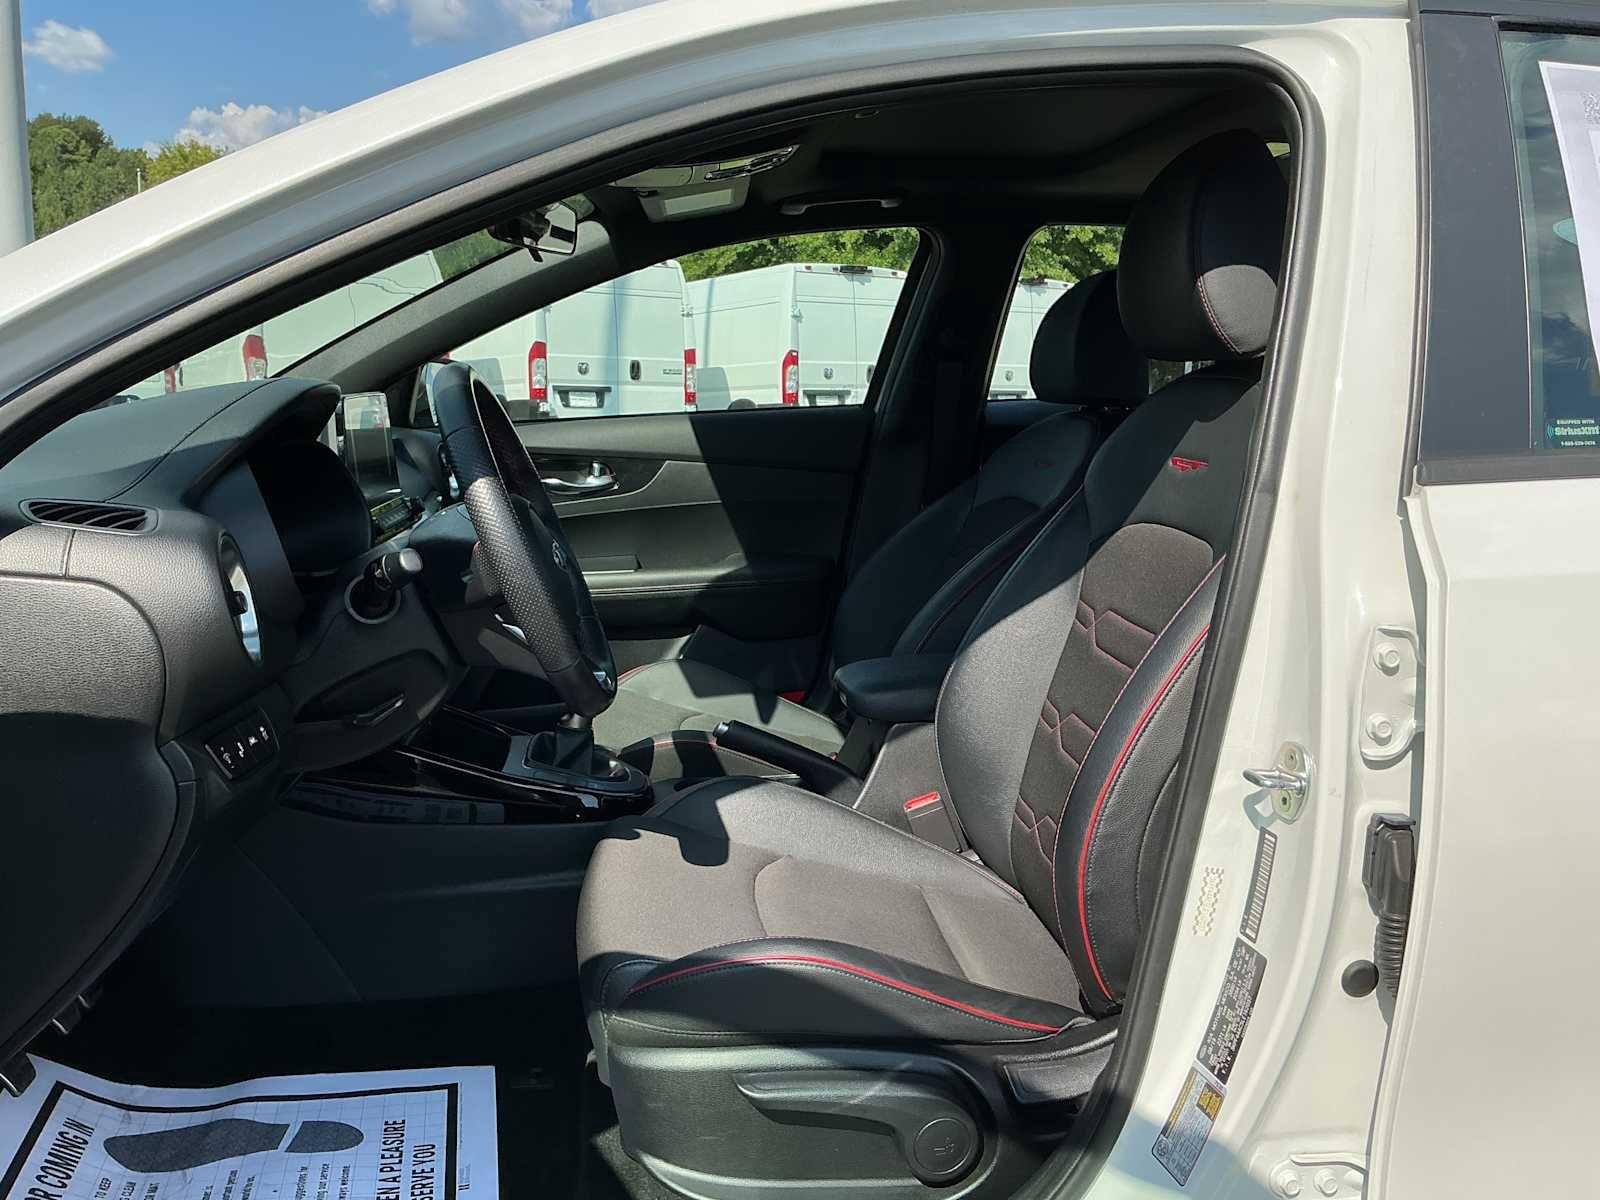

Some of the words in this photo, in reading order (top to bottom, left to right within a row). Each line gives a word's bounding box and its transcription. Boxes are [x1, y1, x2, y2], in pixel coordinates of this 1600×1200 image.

[35, 1131, 89, 1189] COMING
[62, 1117, 95, 1137] IN
[379, 1119, 405, 1173] PLEASURE
[413, 1144, 436, 1166] YOU
[379, 1175, 401, 1183] A
